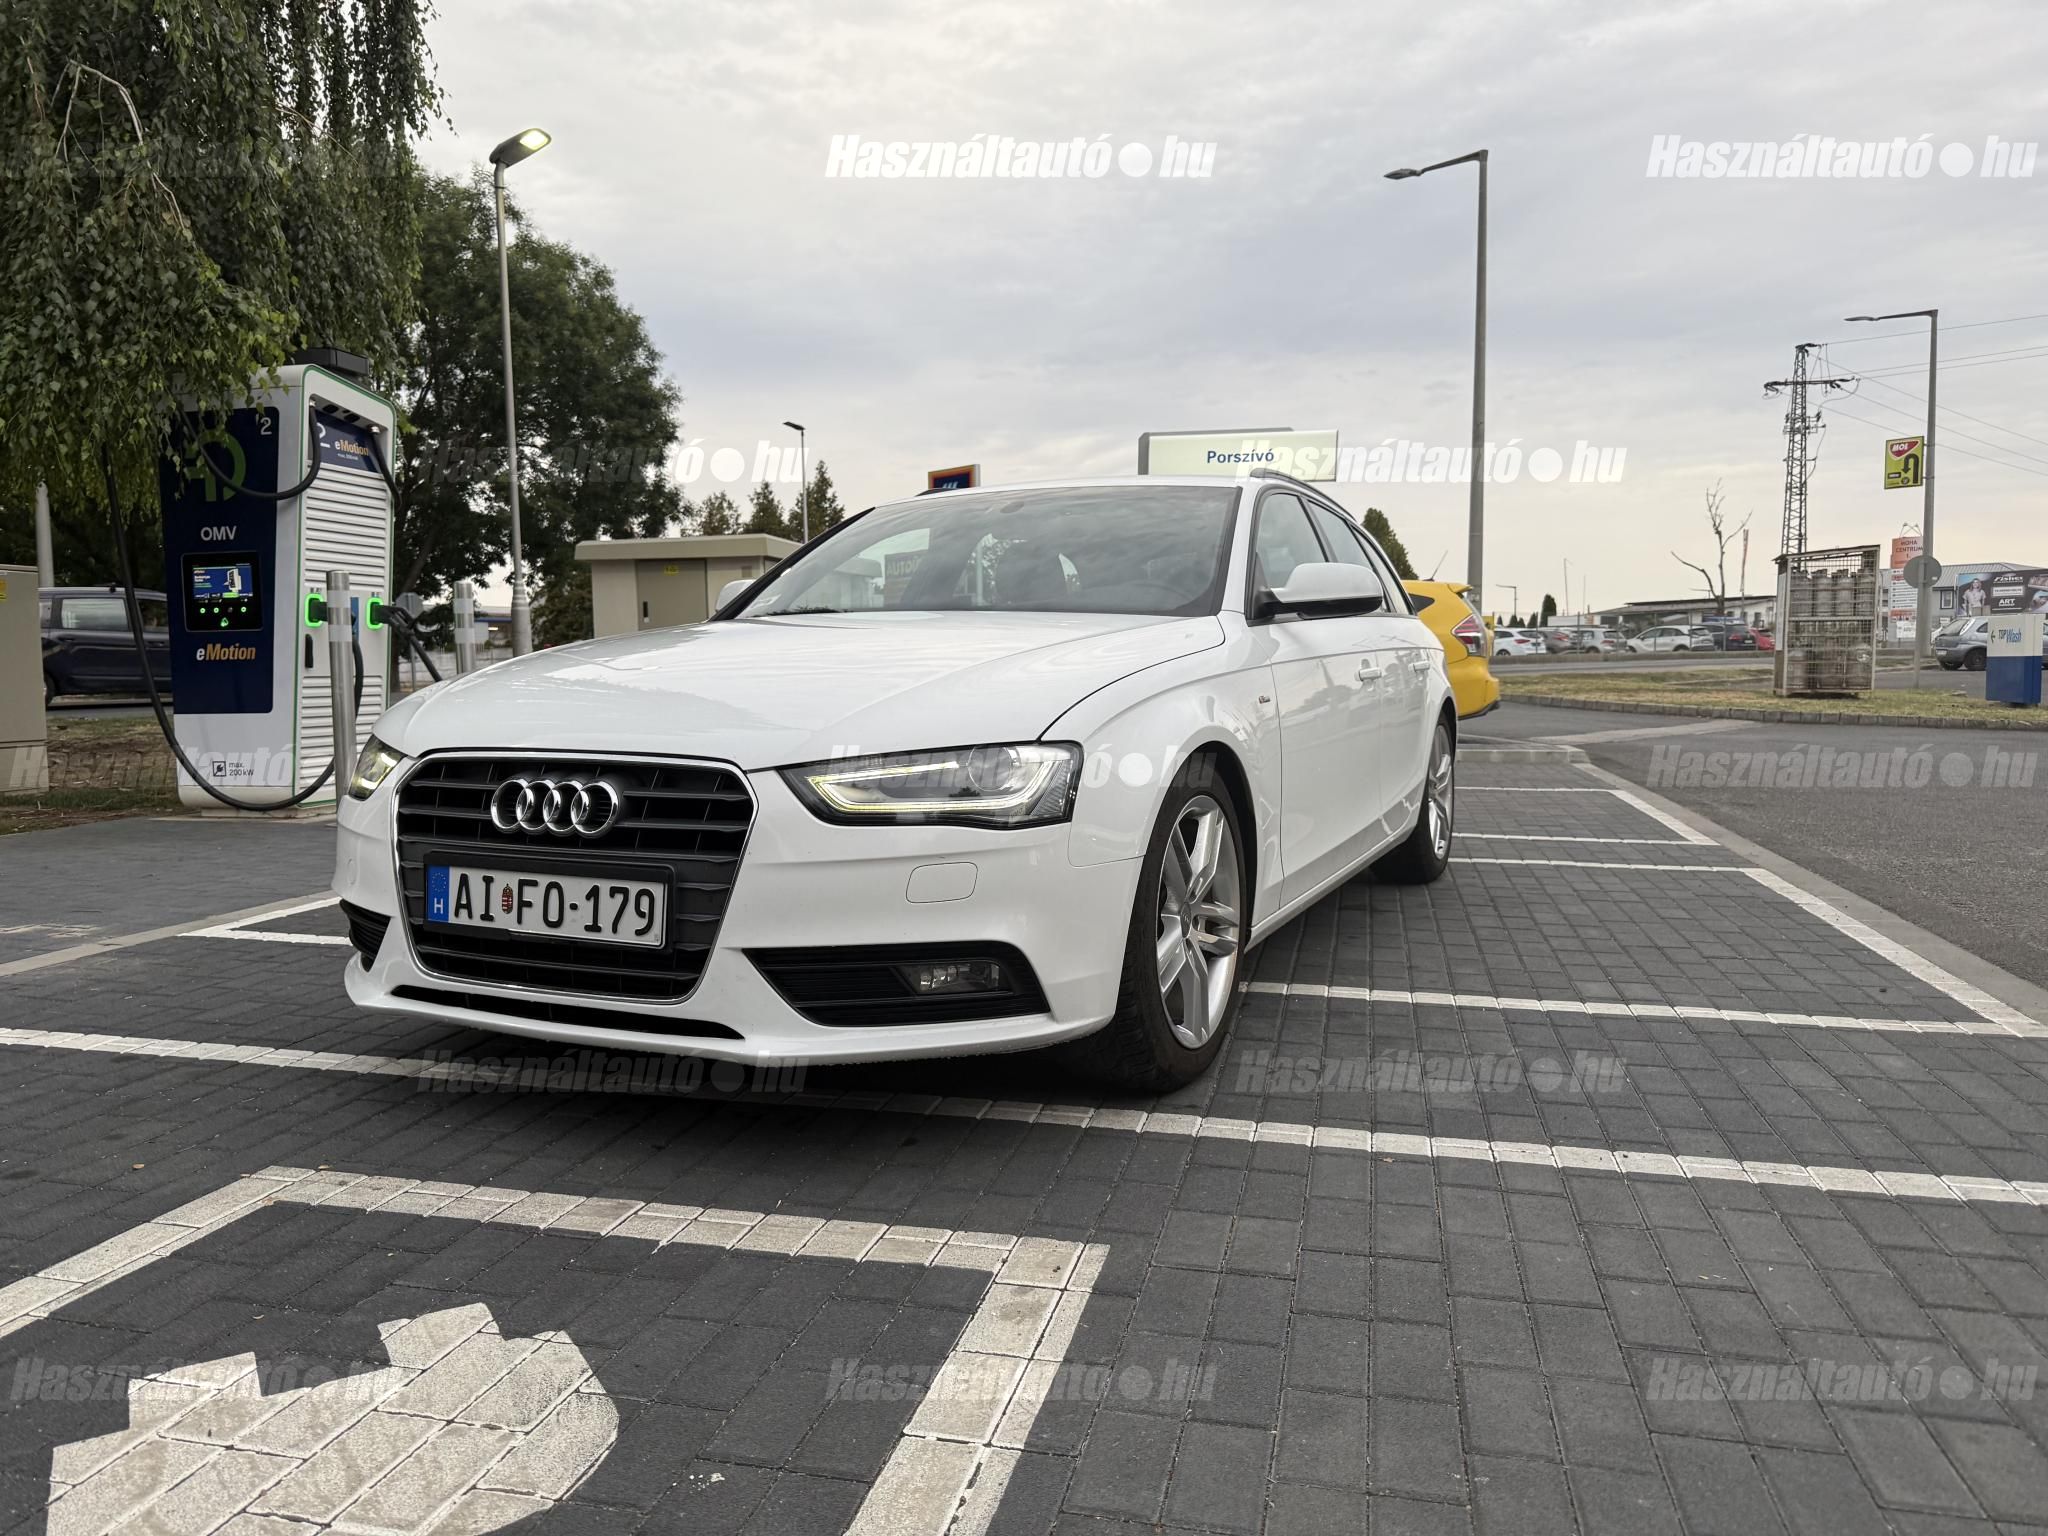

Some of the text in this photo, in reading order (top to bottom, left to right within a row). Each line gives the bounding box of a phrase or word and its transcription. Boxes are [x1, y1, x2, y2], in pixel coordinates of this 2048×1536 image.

[260, 417, 272, 435] 2
[334, 440, 369, 456] eMotion
[1892, 443, 1909, 452] MOL
[1207, 448, 1274, 464] Porszívó
[200, 526, 237, 541] OMV
[196, 643, 257, 661] eMotion
[433, 898, 444, 915] H
